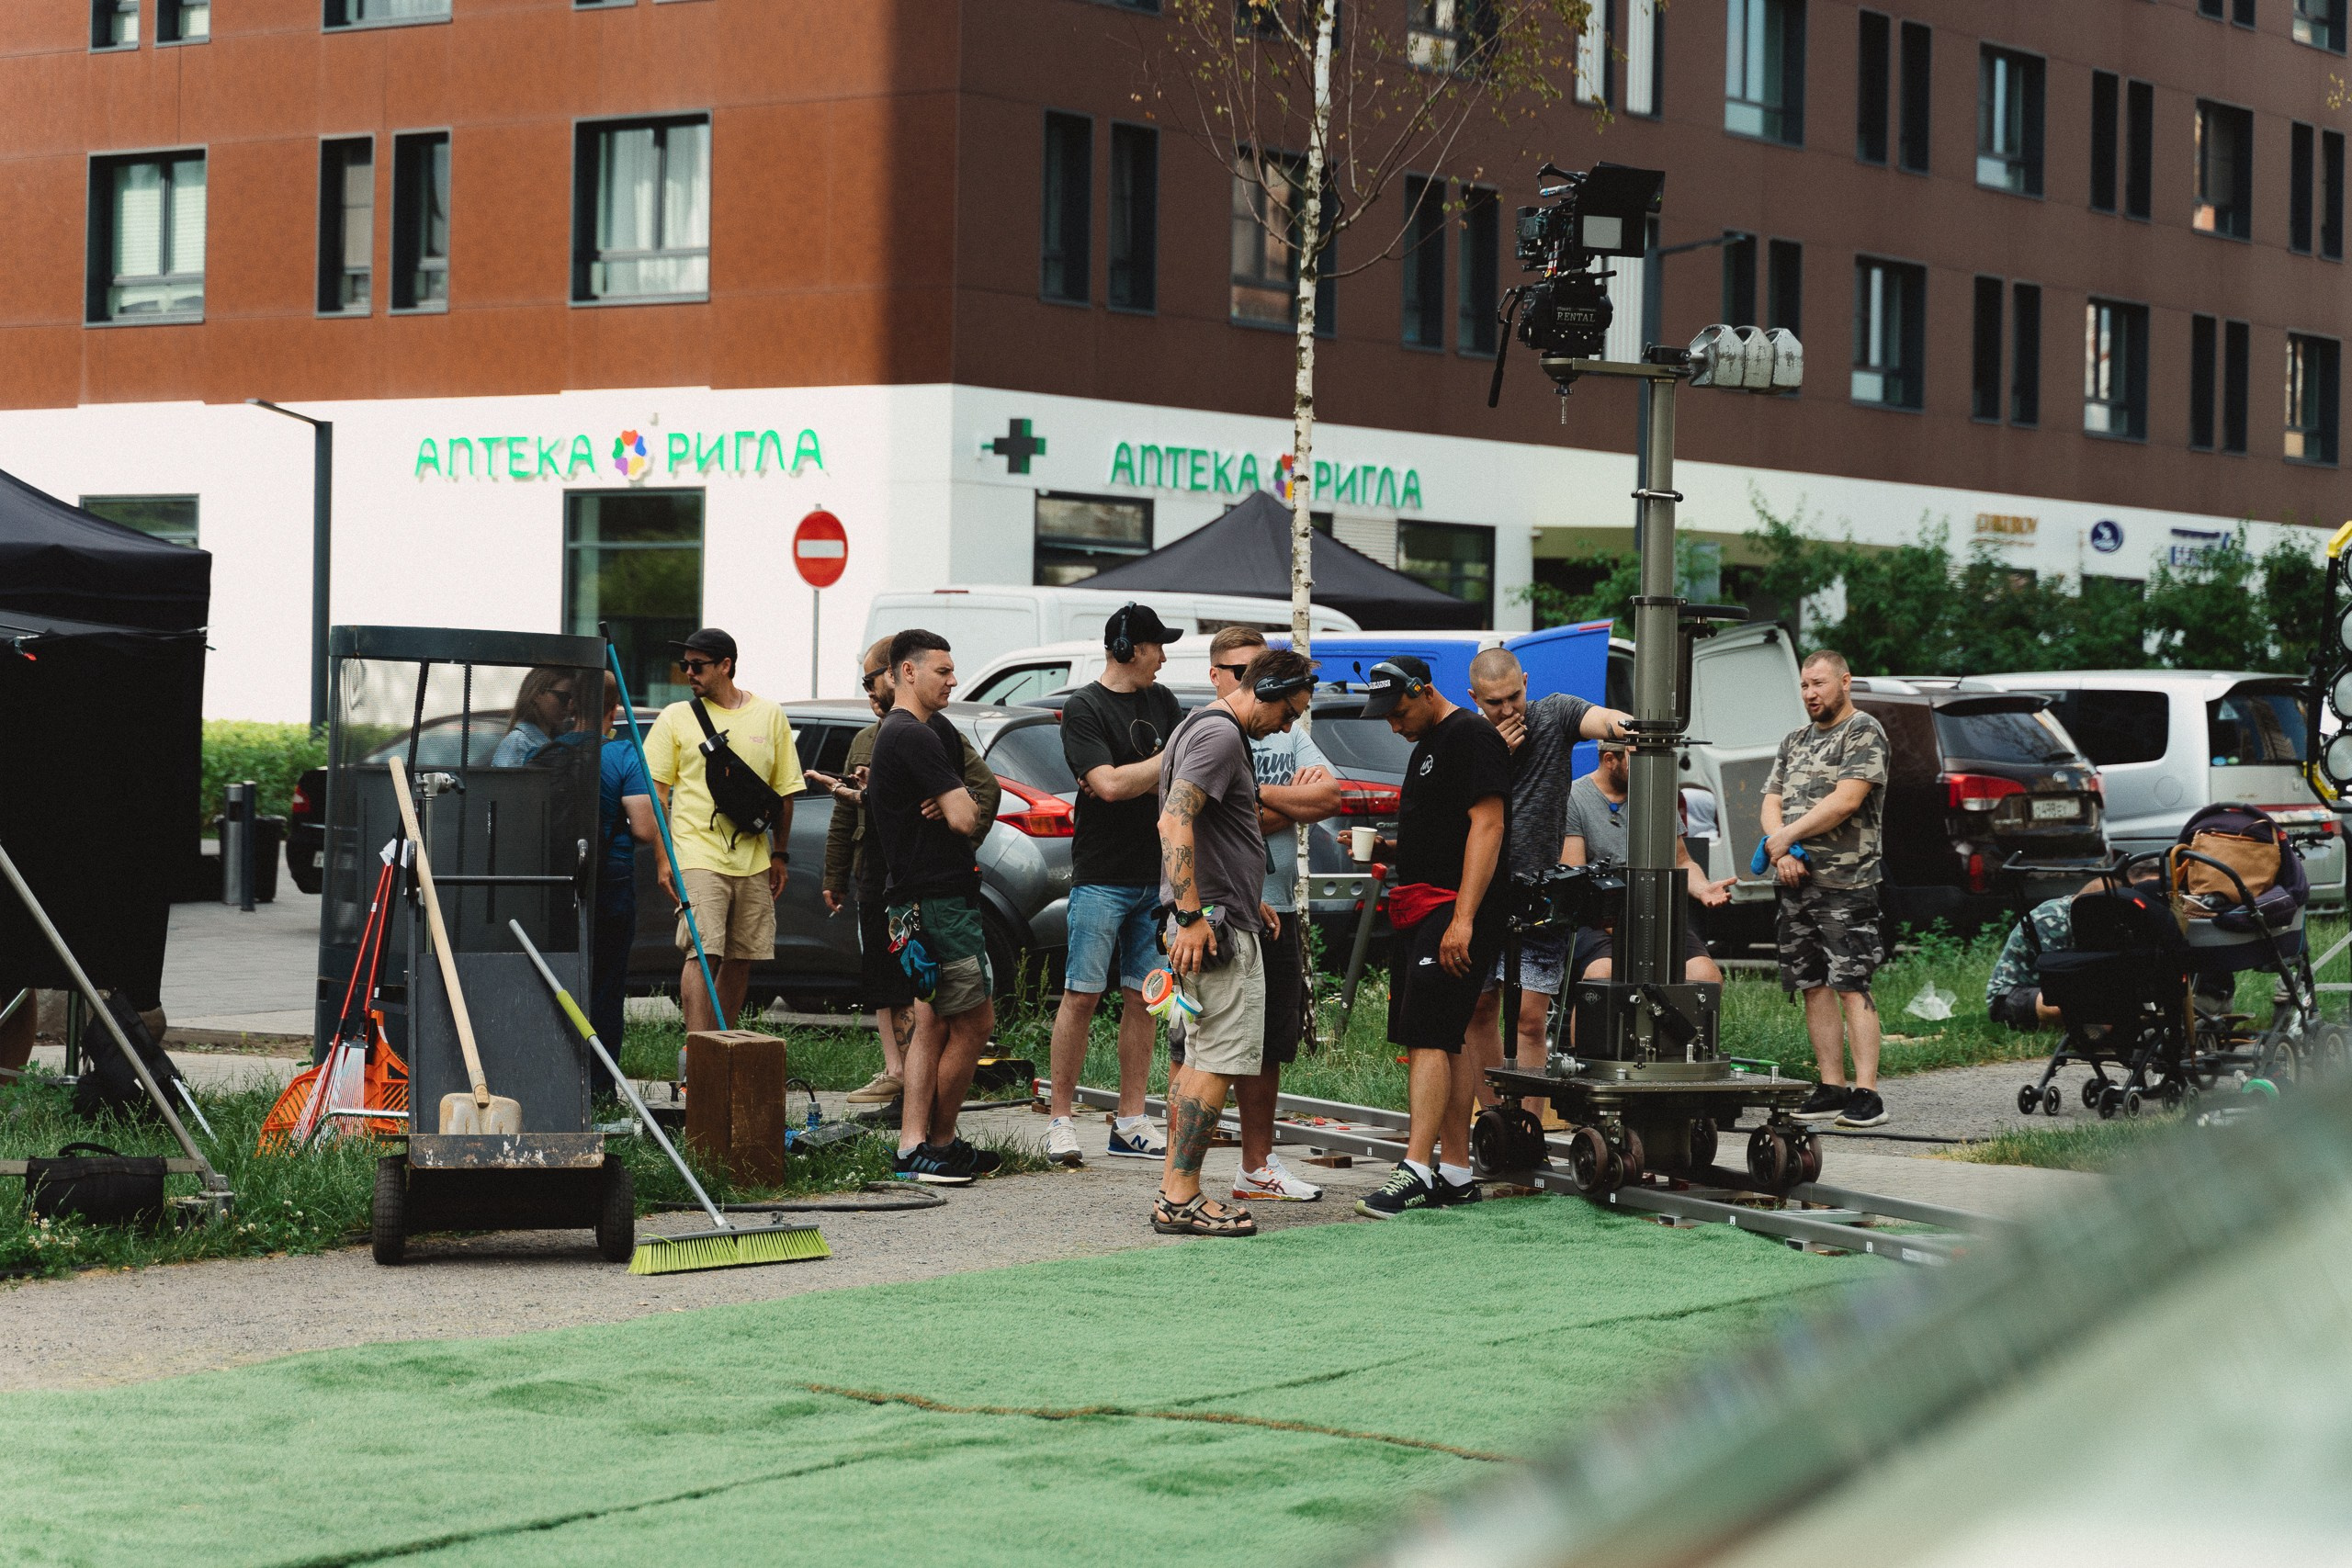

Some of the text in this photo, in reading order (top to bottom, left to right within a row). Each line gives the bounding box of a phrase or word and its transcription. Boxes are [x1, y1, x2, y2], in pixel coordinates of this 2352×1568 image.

[1556, 311, 1596, 322] RENTAL
[414, 428, 825, 479] АПТЕКА РИГЛА
[1110, 441, 1423, 510] АПТЕКА РИГЛА
